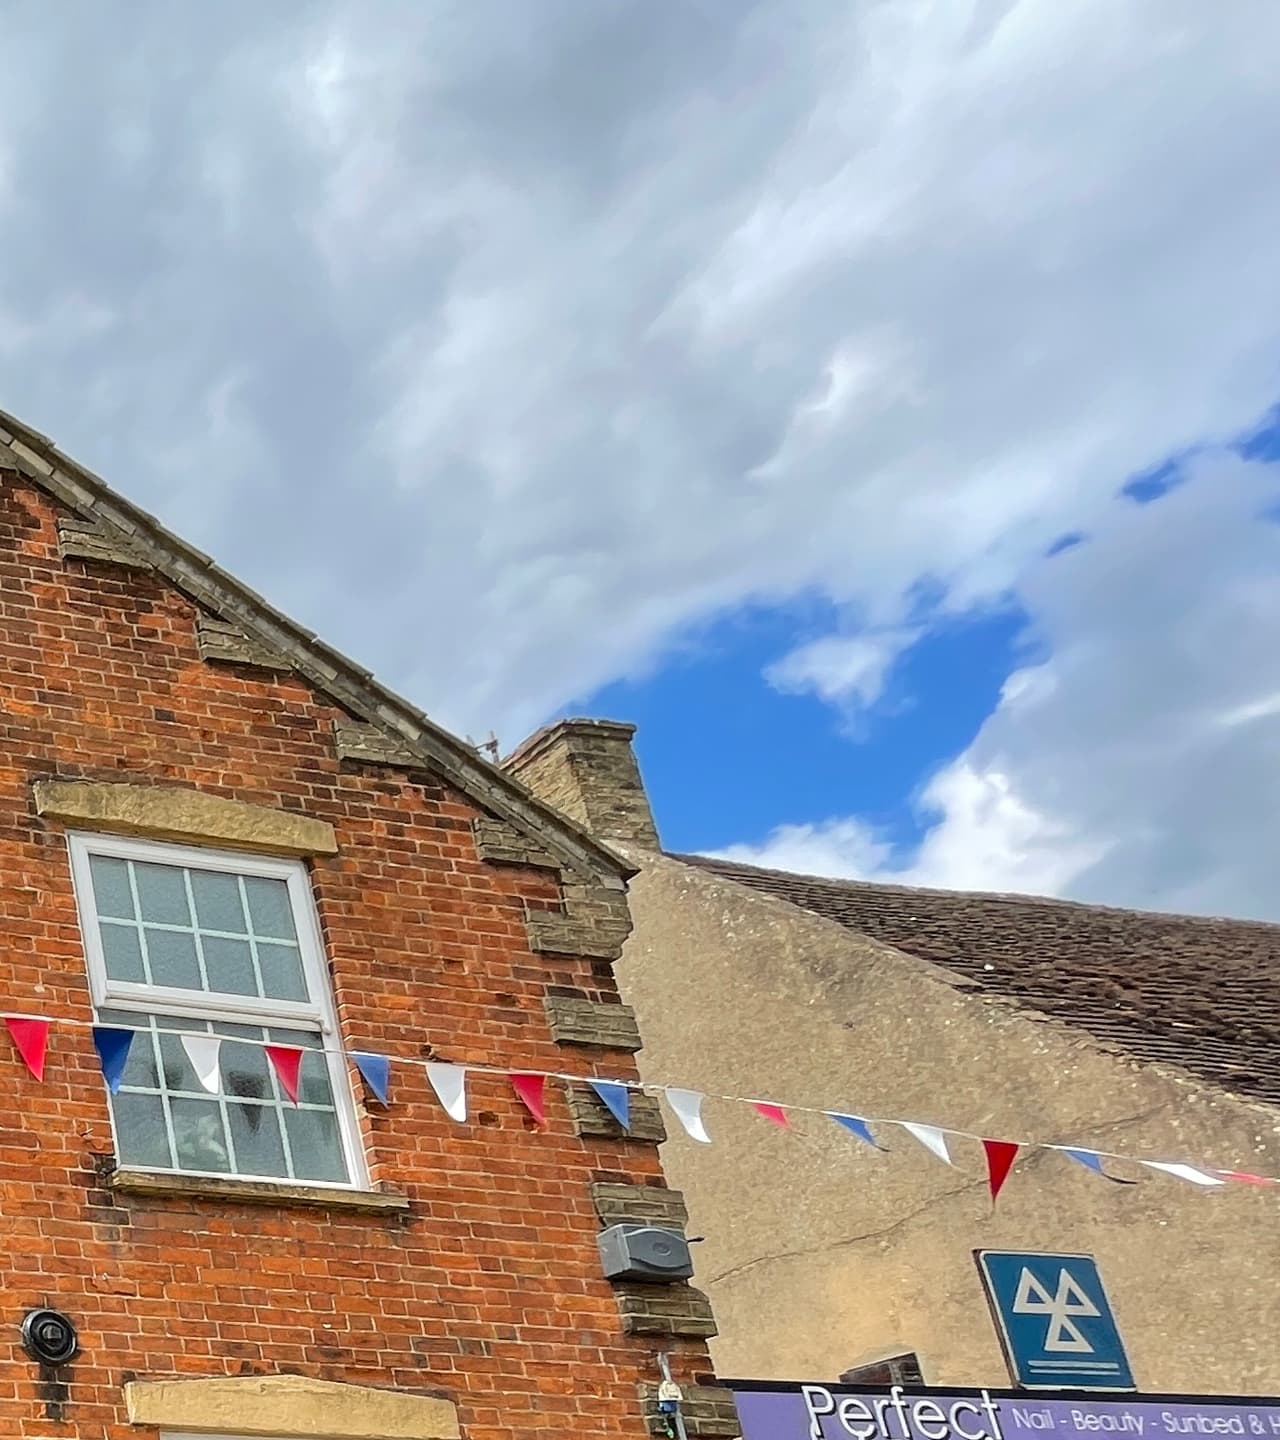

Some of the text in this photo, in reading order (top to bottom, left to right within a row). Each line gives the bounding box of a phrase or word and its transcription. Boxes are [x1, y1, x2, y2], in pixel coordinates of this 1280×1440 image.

[801, 1385, 1003, 1440] Perfect
[1012, 1408, 1055, 1430] Nail
[1071, 1409, 1144, 1435] Beauty
[1161, 1412, 1245, 1434] Sunbed
